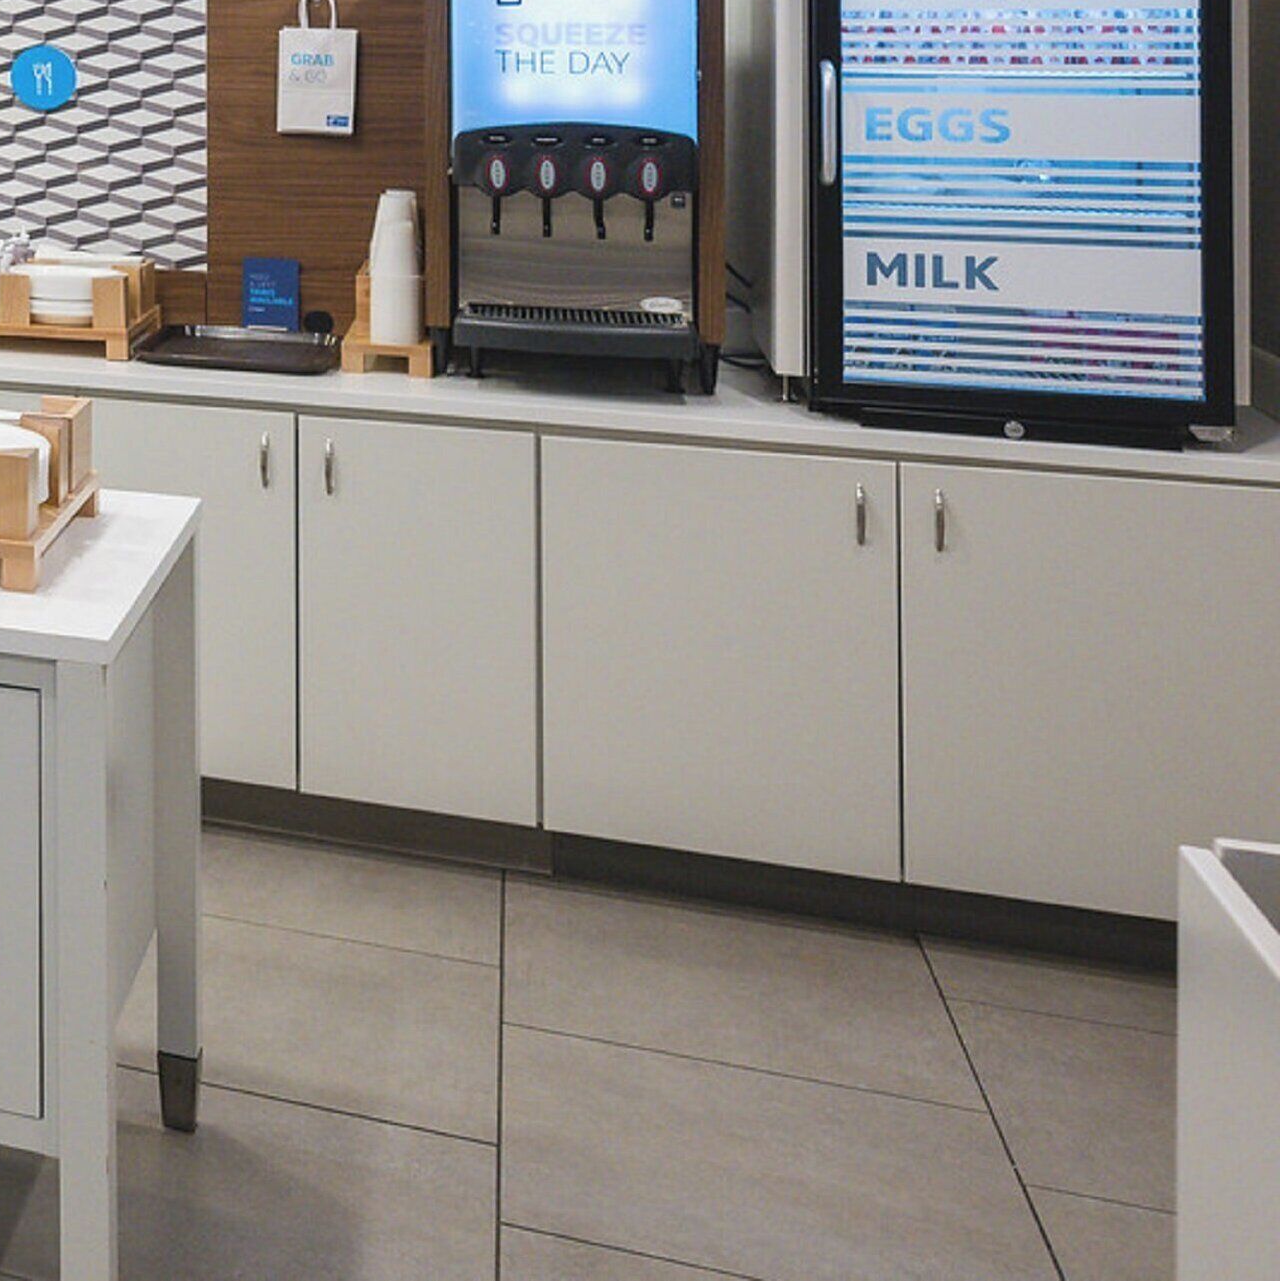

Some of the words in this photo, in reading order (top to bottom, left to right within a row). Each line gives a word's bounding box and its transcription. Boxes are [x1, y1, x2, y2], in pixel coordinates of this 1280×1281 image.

[495, 22, 647, 46] SQUEEZE
[290, 52, 335, 67] GRAB
[495, 49, 555, 74] THE
[569, 51, 630, 75] DAY
[865, 107, 1012, 144] EGGS
[866, 251, 1000, 291] MILK
